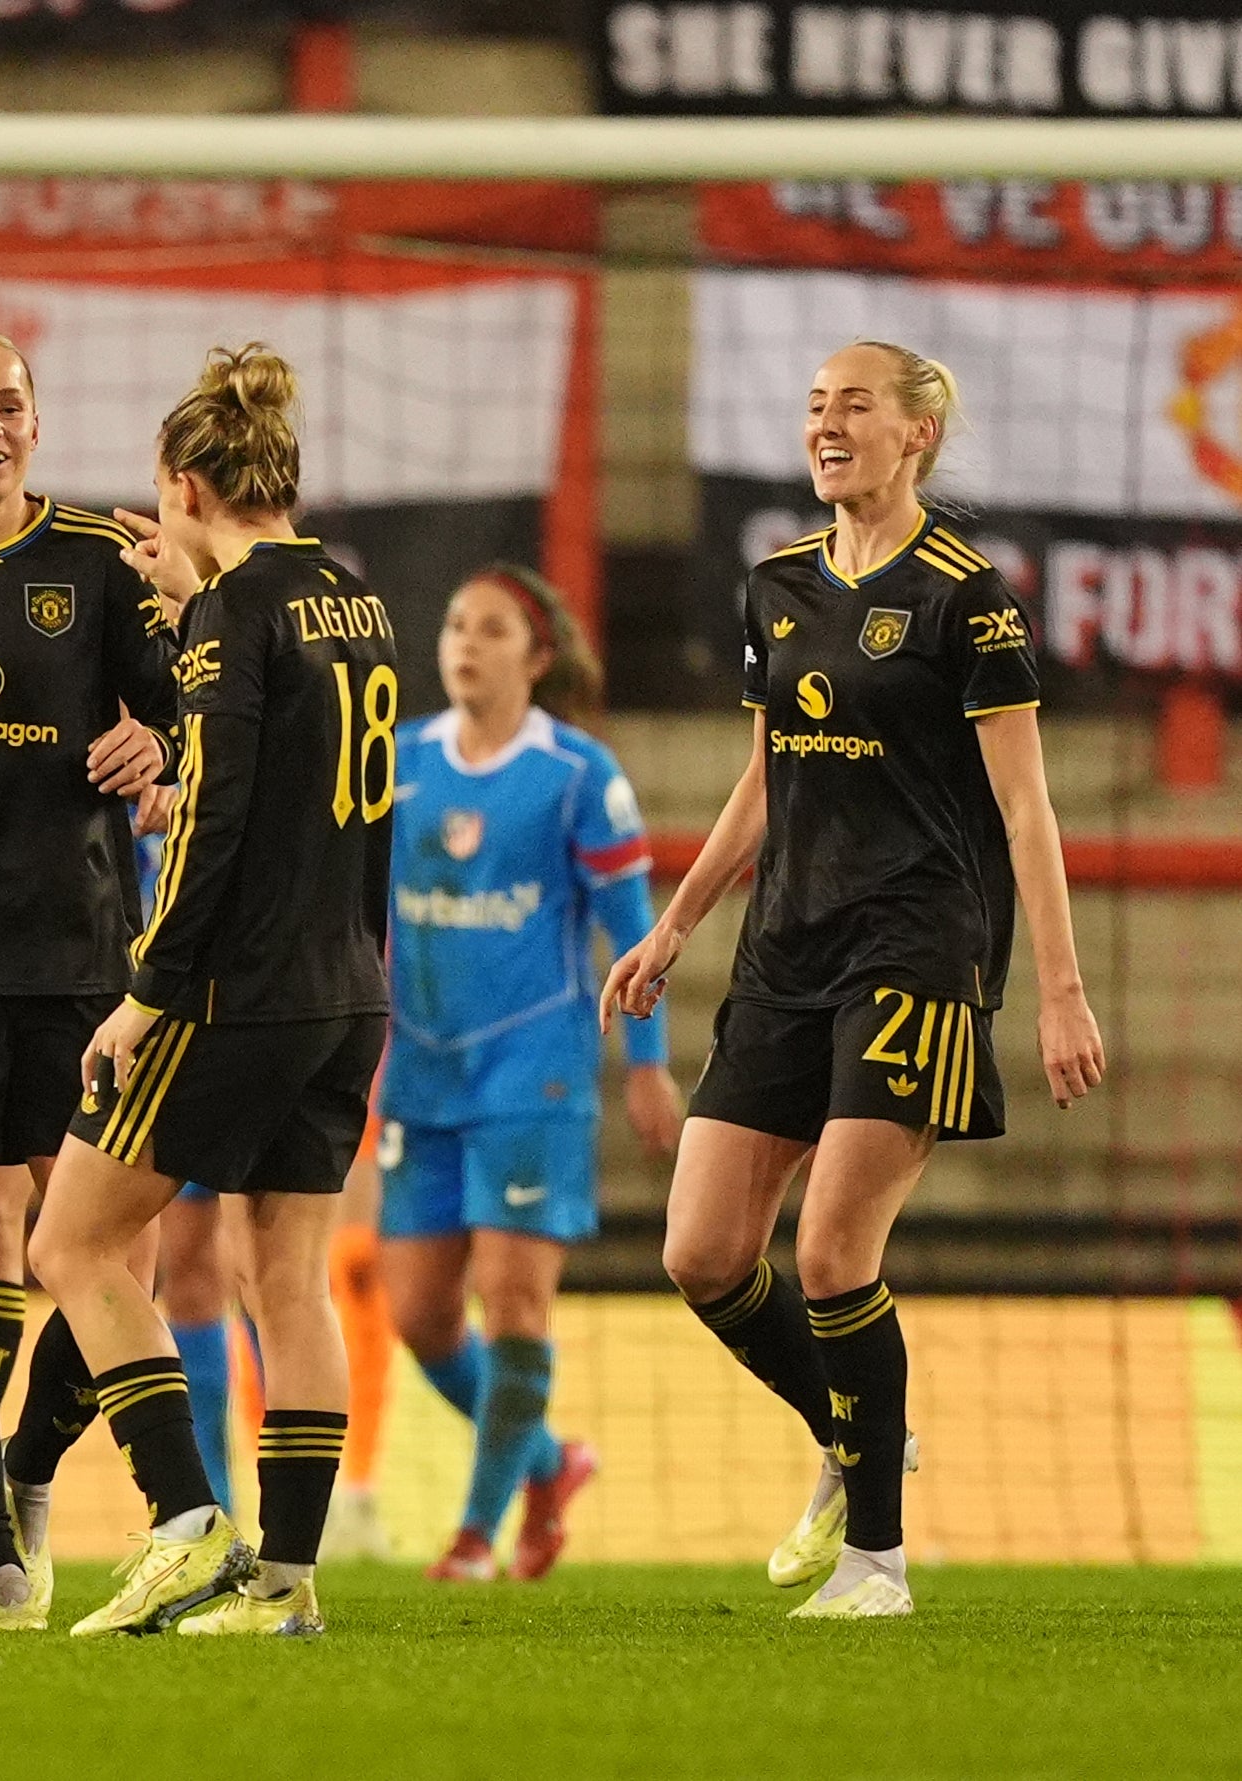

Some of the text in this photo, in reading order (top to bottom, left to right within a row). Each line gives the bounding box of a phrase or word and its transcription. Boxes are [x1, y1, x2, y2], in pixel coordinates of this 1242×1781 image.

[608, 3, 771, 95] SHE
[791, 6, 1057, 107] NEVER
[331, 662, 398, 830] 18
[770, 729, 885, 761] Snapdragon
[861, 986, 938, 1072] 21
